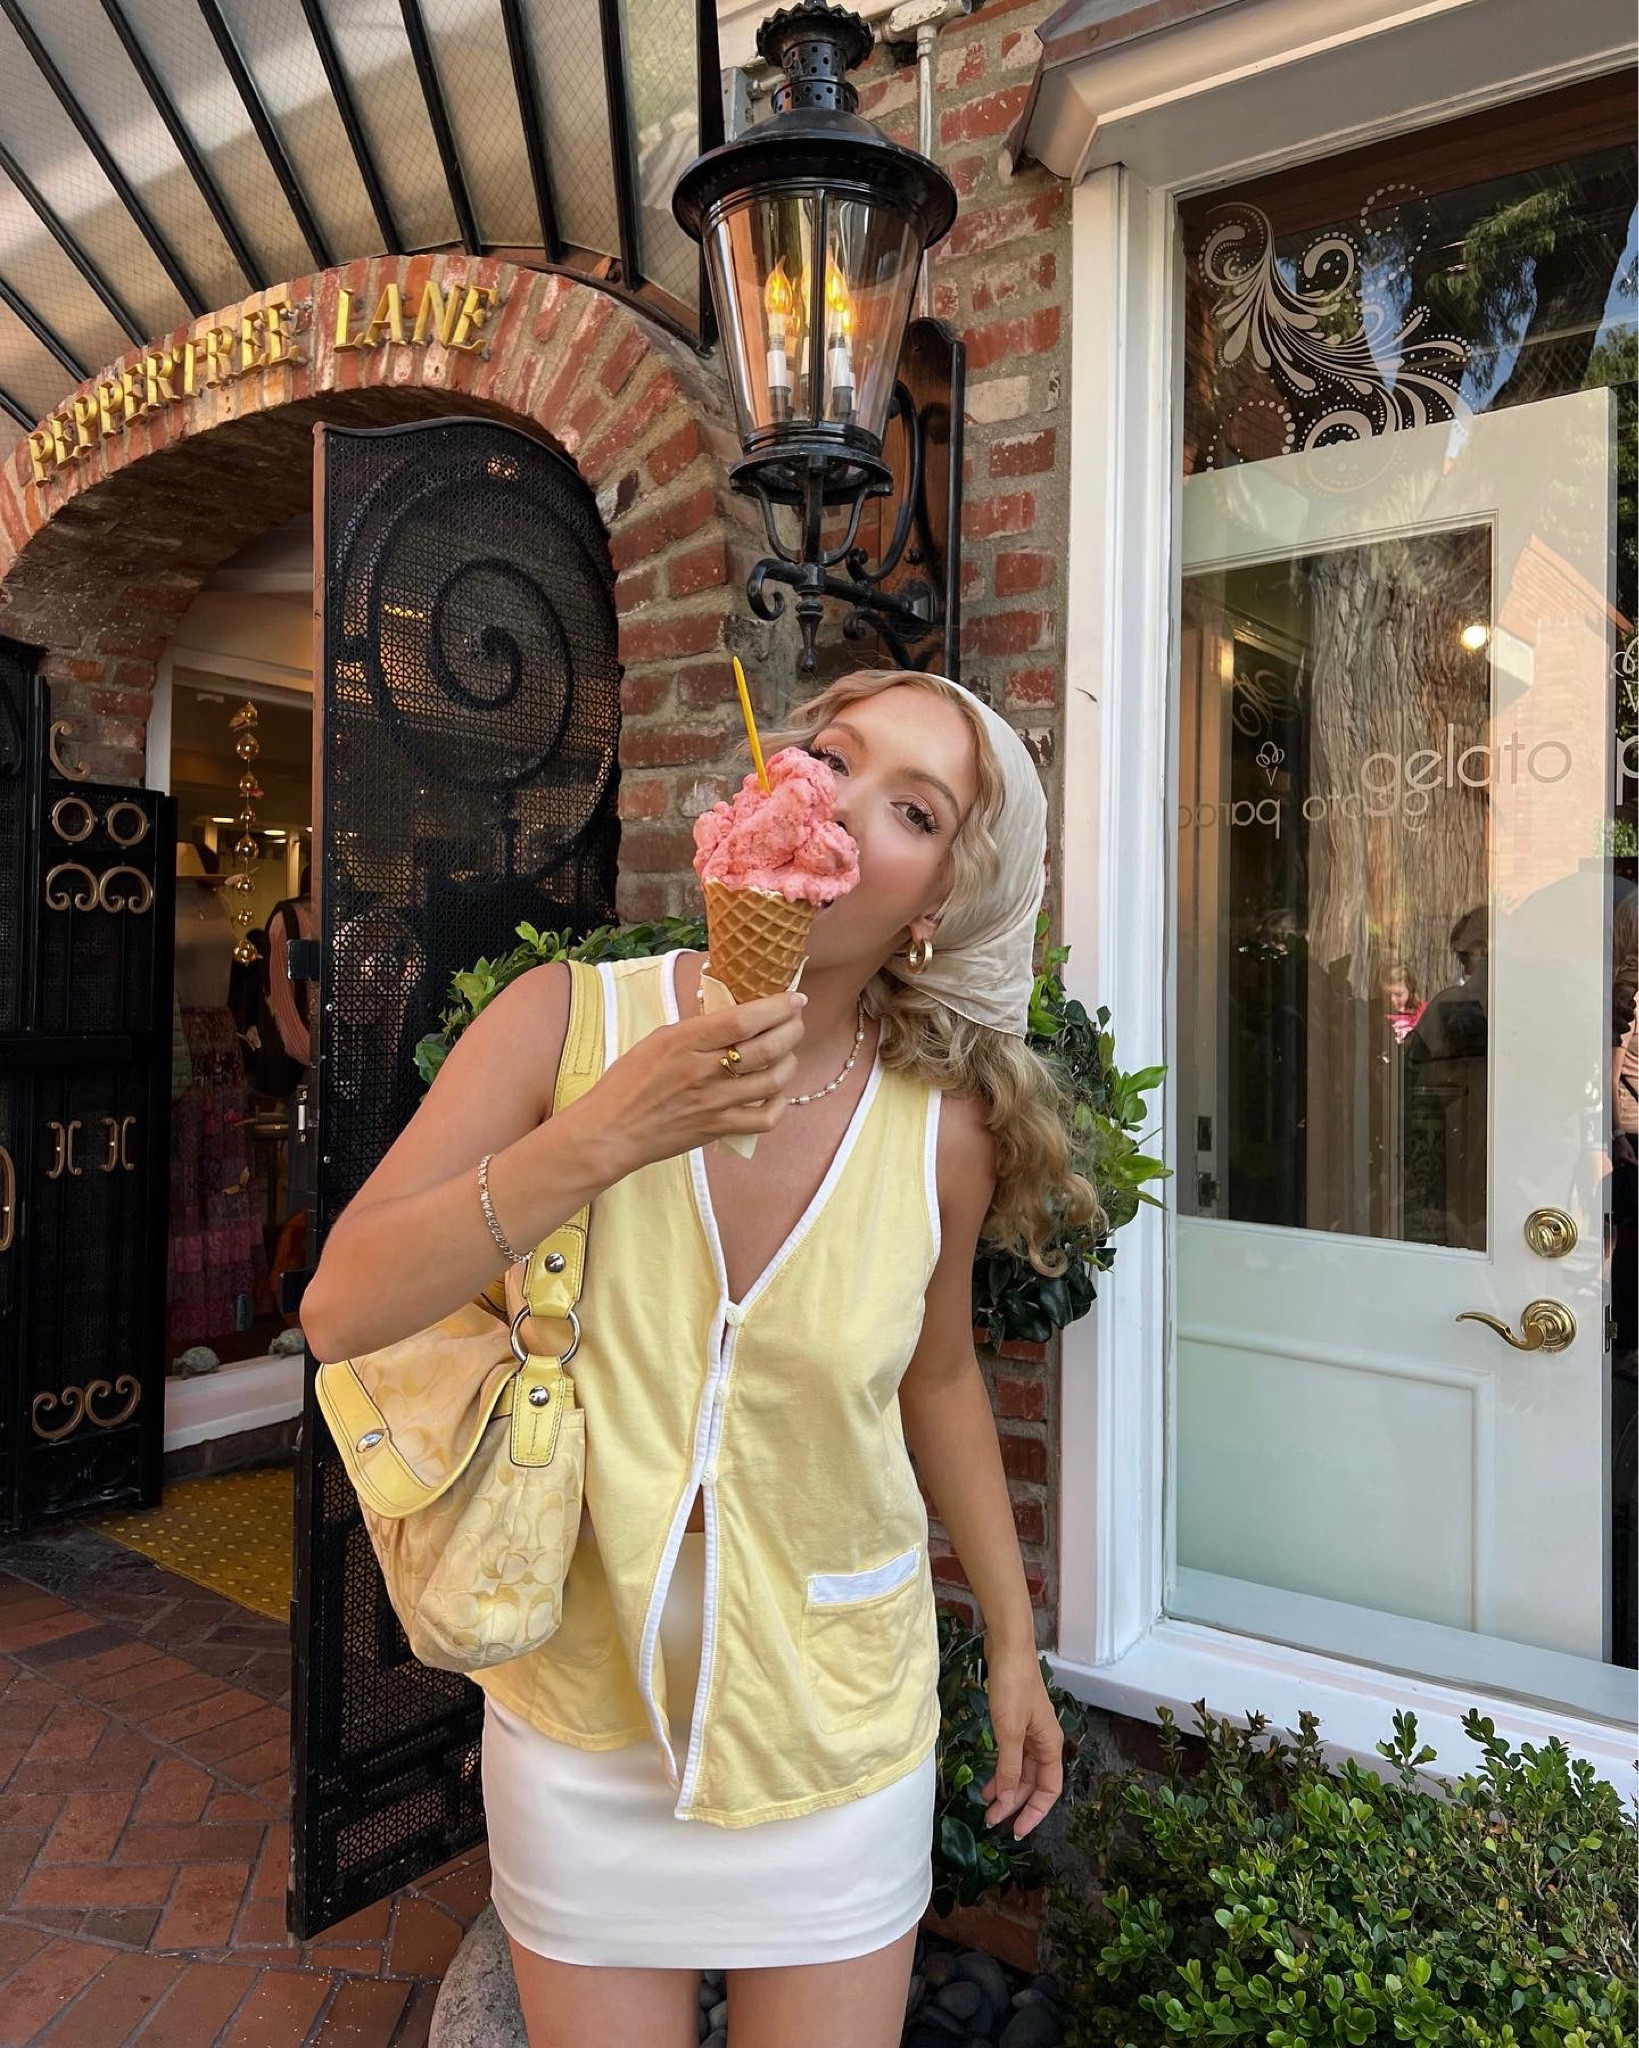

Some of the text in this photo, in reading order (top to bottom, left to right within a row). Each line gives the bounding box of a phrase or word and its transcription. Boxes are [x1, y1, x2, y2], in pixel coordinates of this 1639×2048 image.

[27, 280, 497, 488] PEPPERTREE LANE
[1361, 724, 1572, 817] gelato
